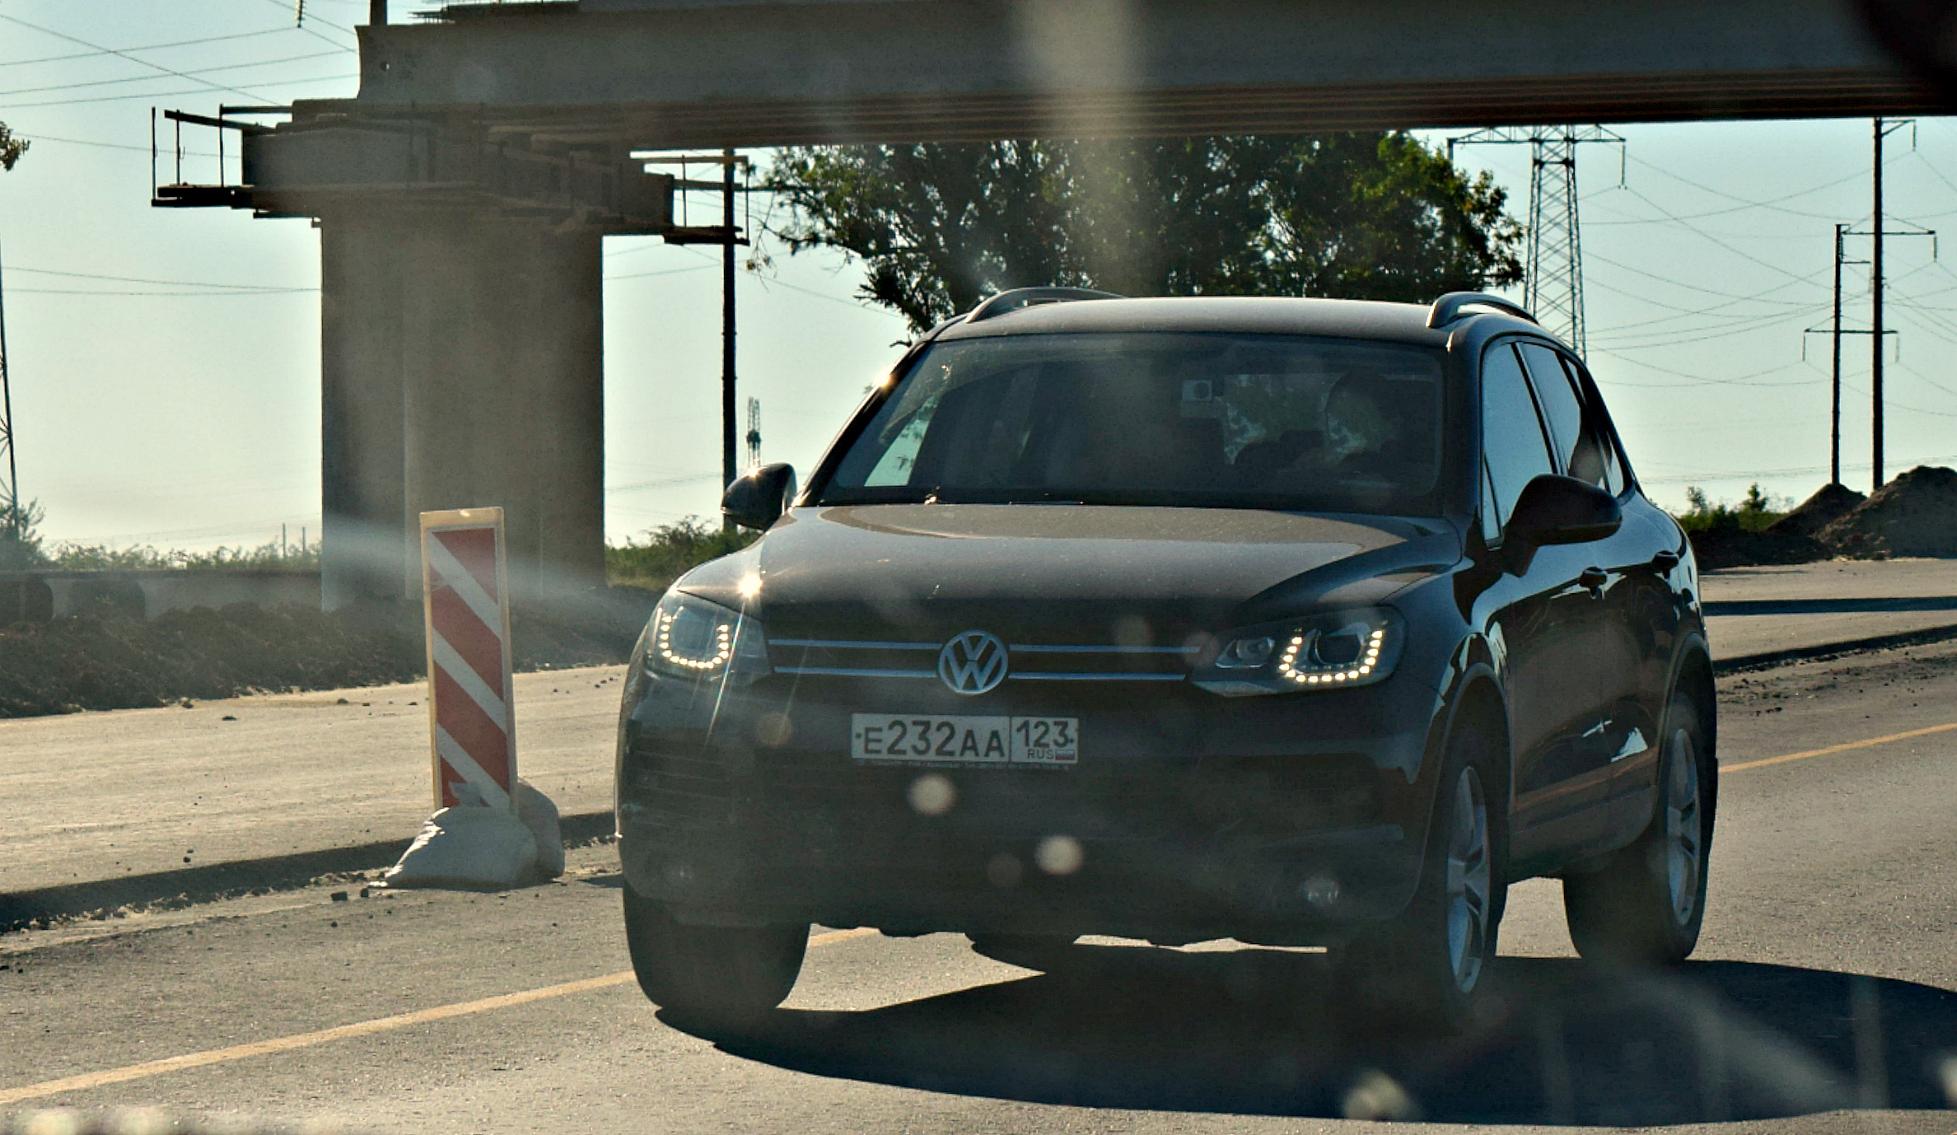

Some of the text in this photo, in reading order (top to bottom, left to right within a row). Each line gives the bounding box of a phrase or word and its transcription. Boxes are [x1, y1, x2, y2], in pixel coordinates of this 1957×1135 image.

[864, 719, 1069, 757] E232AA 123
[1027, 749, 1054, 760] RUS
